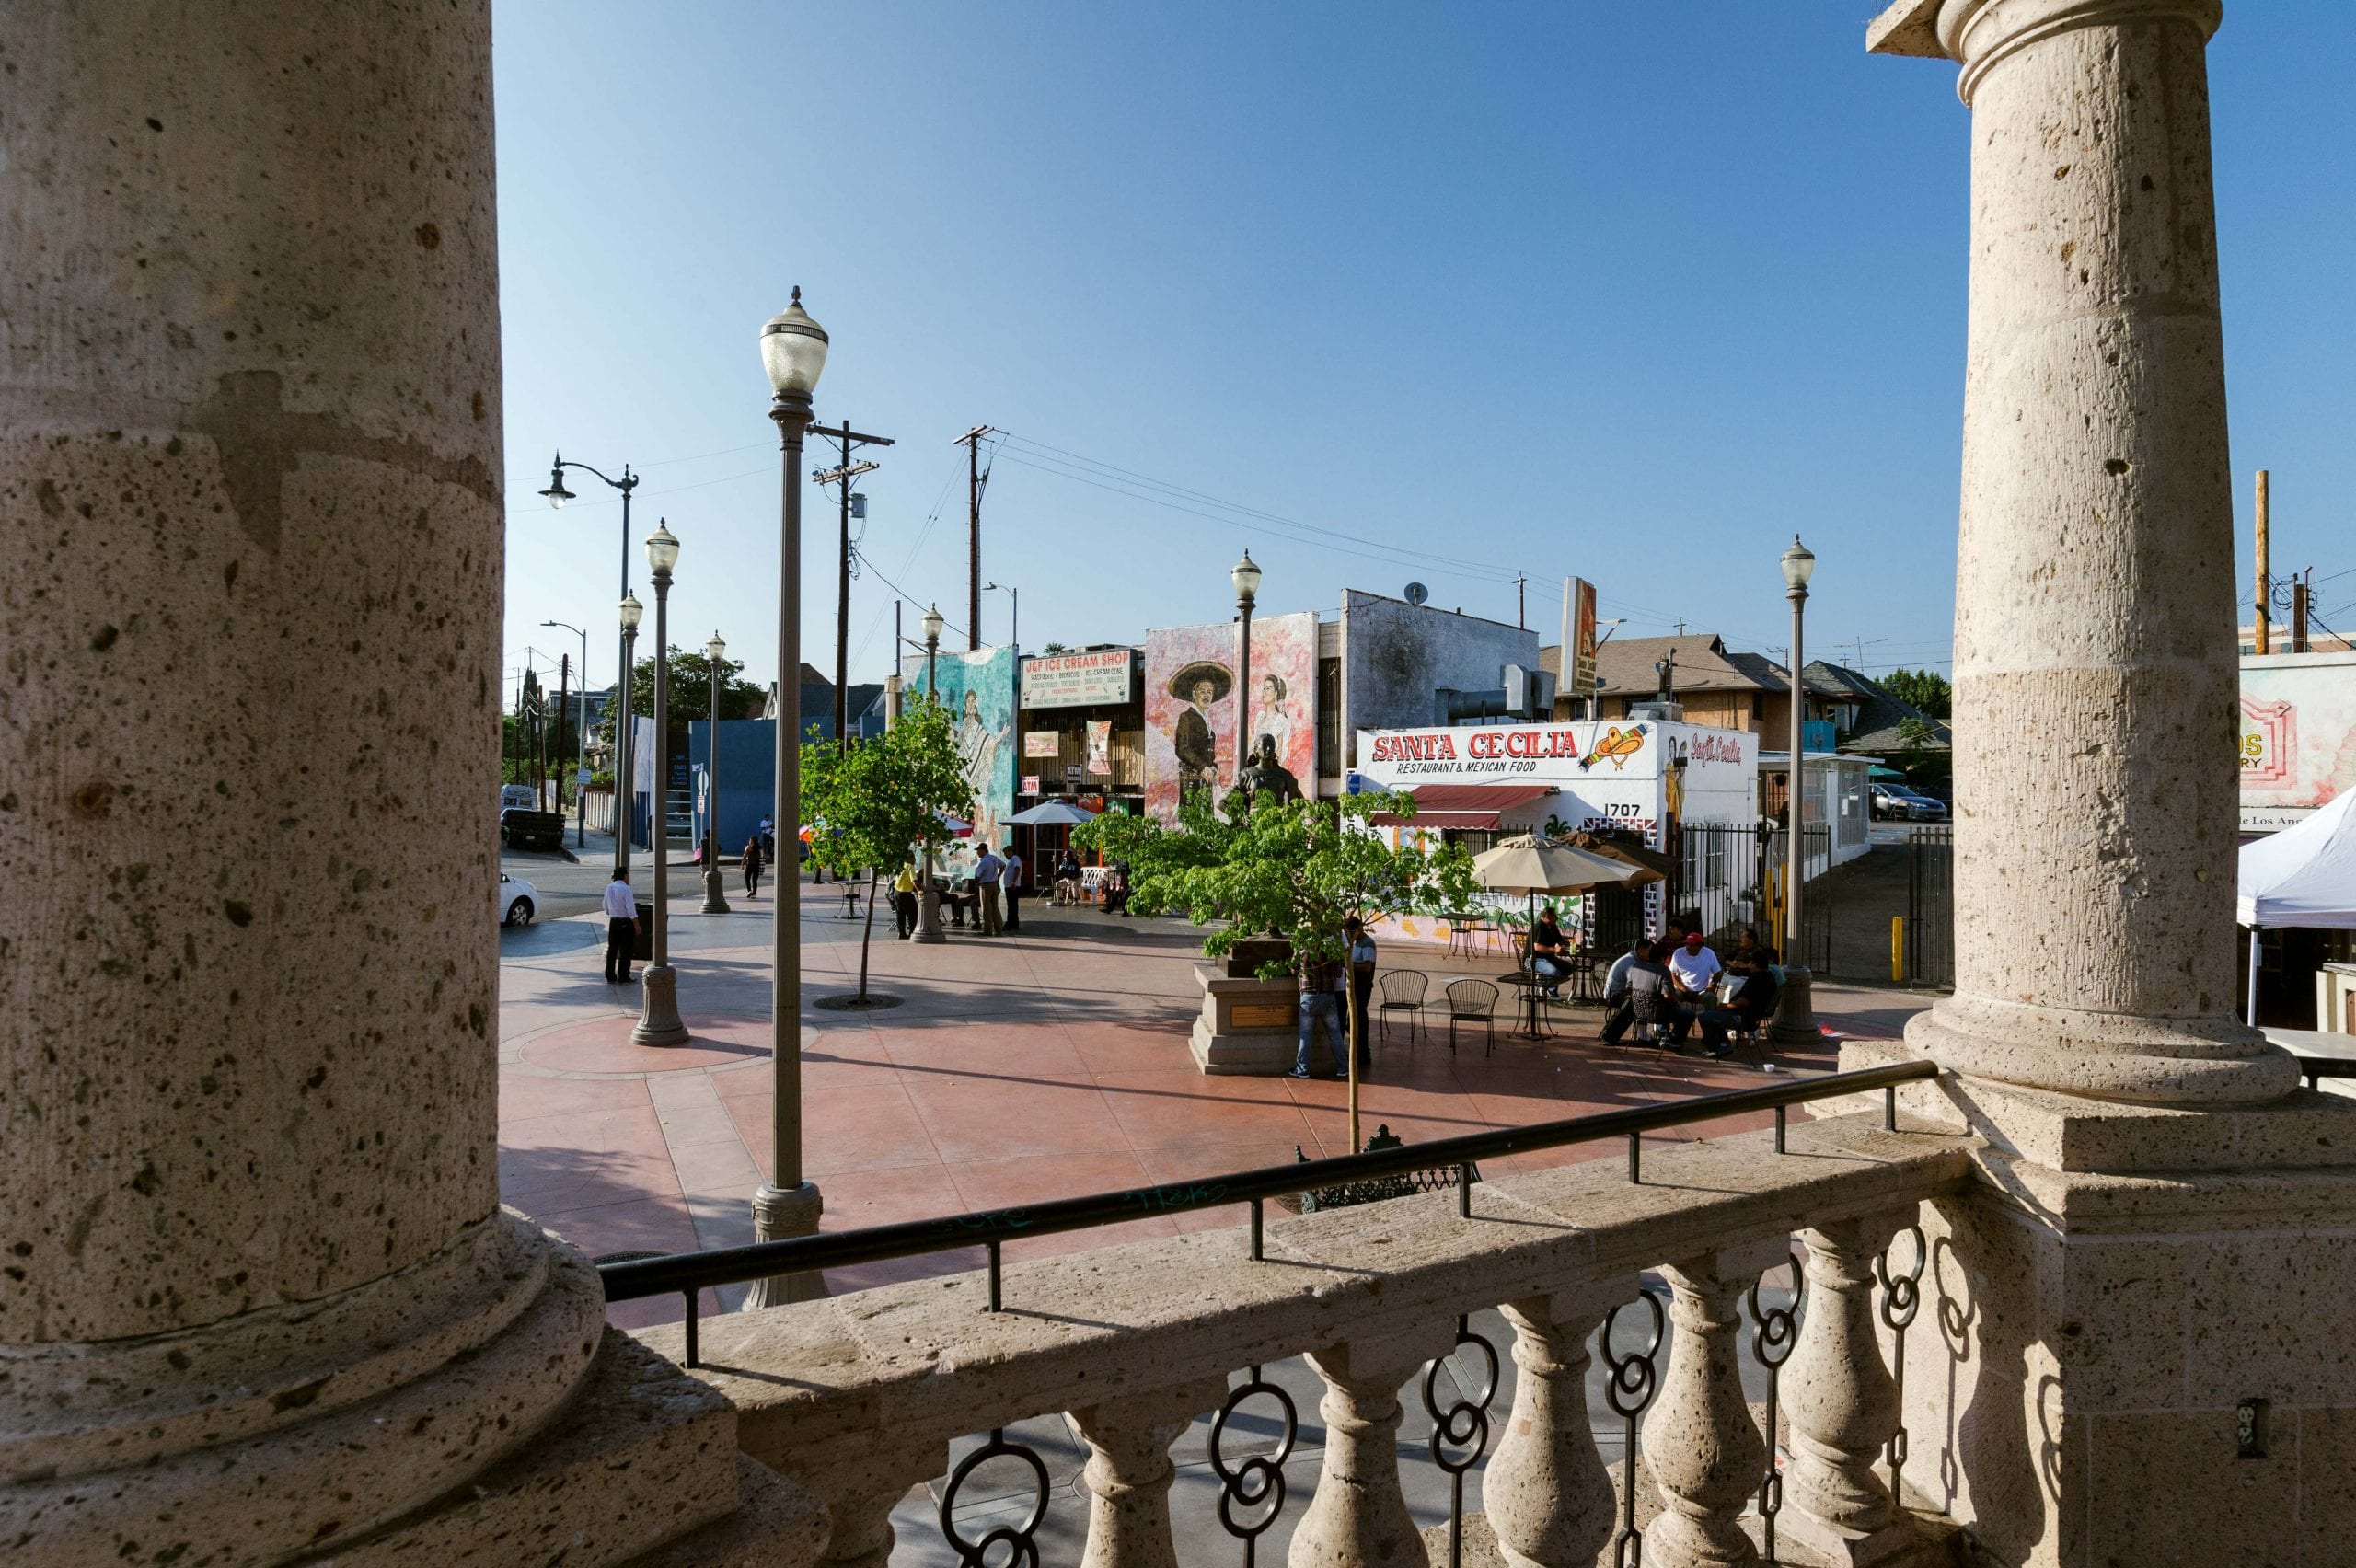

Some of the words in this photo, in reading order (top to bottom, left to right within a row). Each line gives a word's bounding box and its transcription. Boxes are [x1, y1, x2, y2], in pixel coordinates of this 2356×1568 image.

[1045, 659, 1060, 671] ICE
[1064, 656, 1098, 669] CREAM
[1102, 652, 1128, 666] SHOP
[1372, 734, 1458, 762] SANTA
[1468, 731, 1579, 758] CECILIA
[1397, 762, 1456, 775] RESTAURANT
[1456, 764, 1462, 773] &
[1466, 762, 1507, 773] MEXICAN
[1509, 761, 1536, 773] FOOD
[1023, 781, 1038, 791] ATM
[1605, 804, 1640, 817] 1707
[2252, 816, 2273, 824] Los
